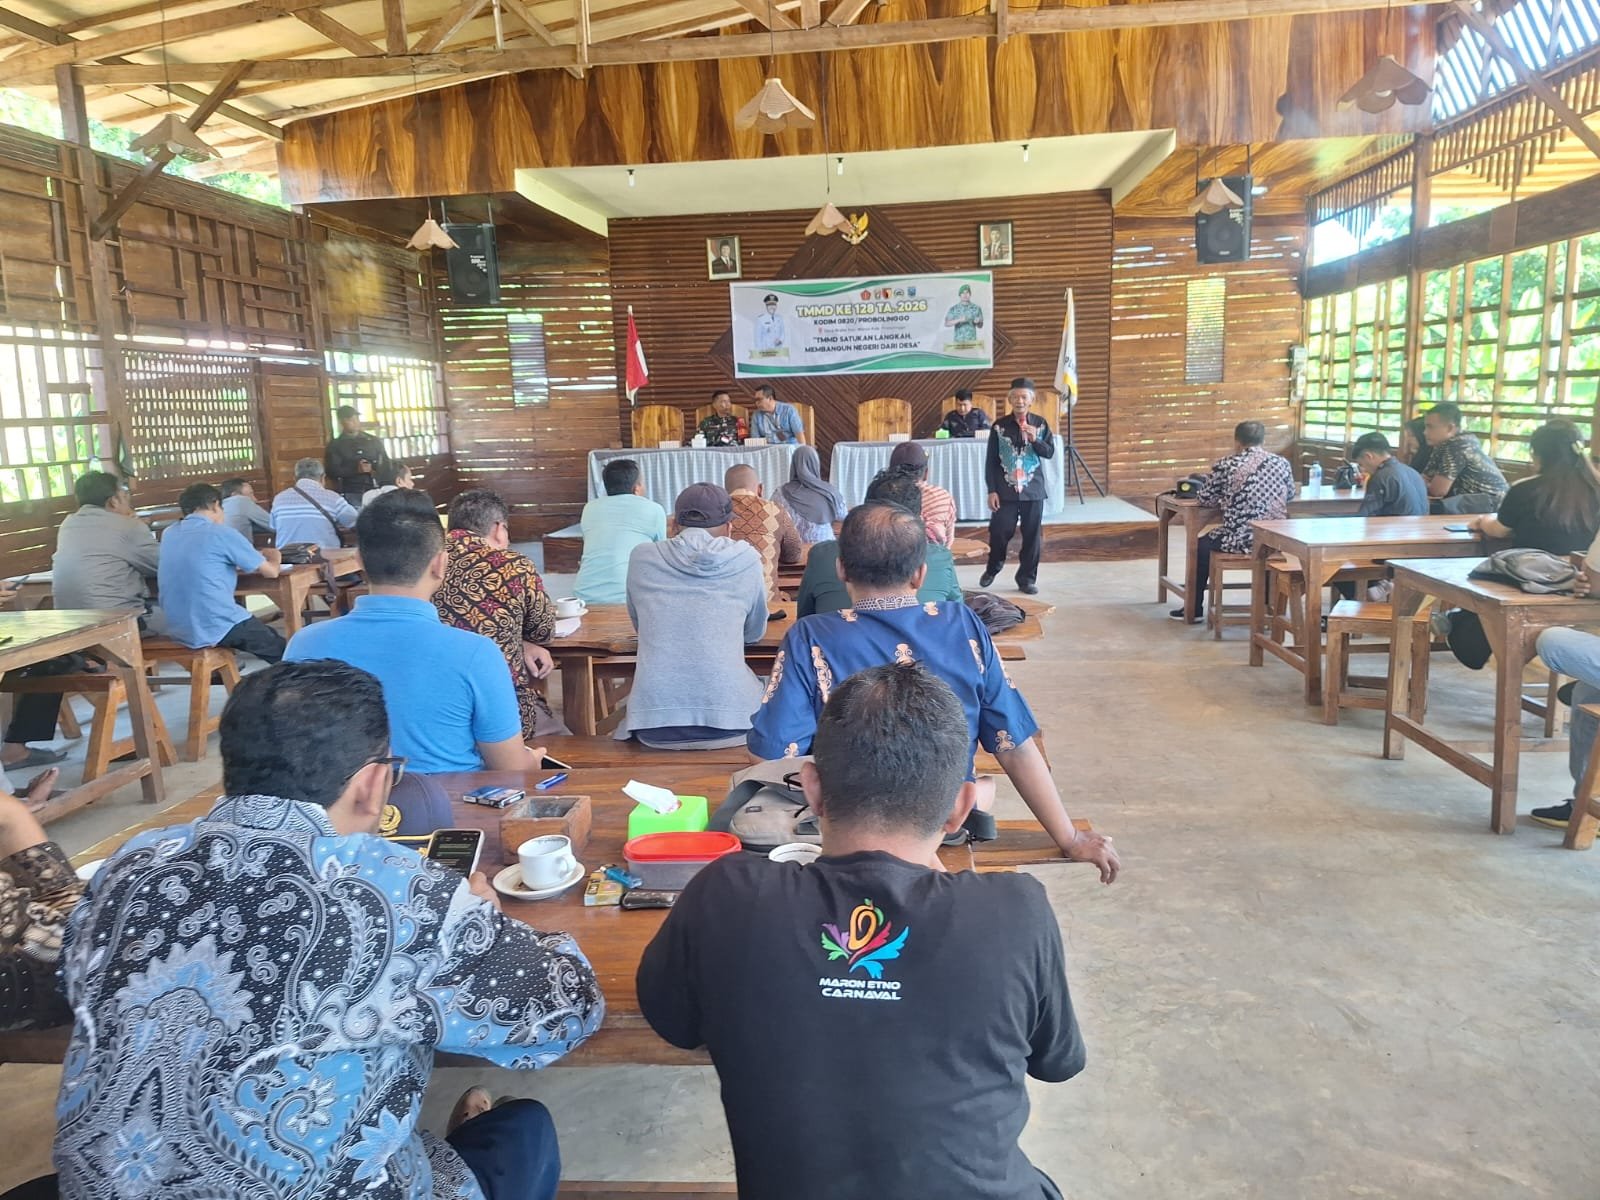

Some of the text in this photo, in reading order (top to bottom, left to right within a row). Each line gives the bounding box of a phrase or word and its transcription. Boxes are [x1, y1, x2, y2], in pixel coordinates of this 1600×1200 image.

[796, 299, 928, 317] TMMD KE 128 TA. 2026
[819, 978, 902, 990] MARON ETNO
[821, 988, 902, 1000] CARNAVAL
